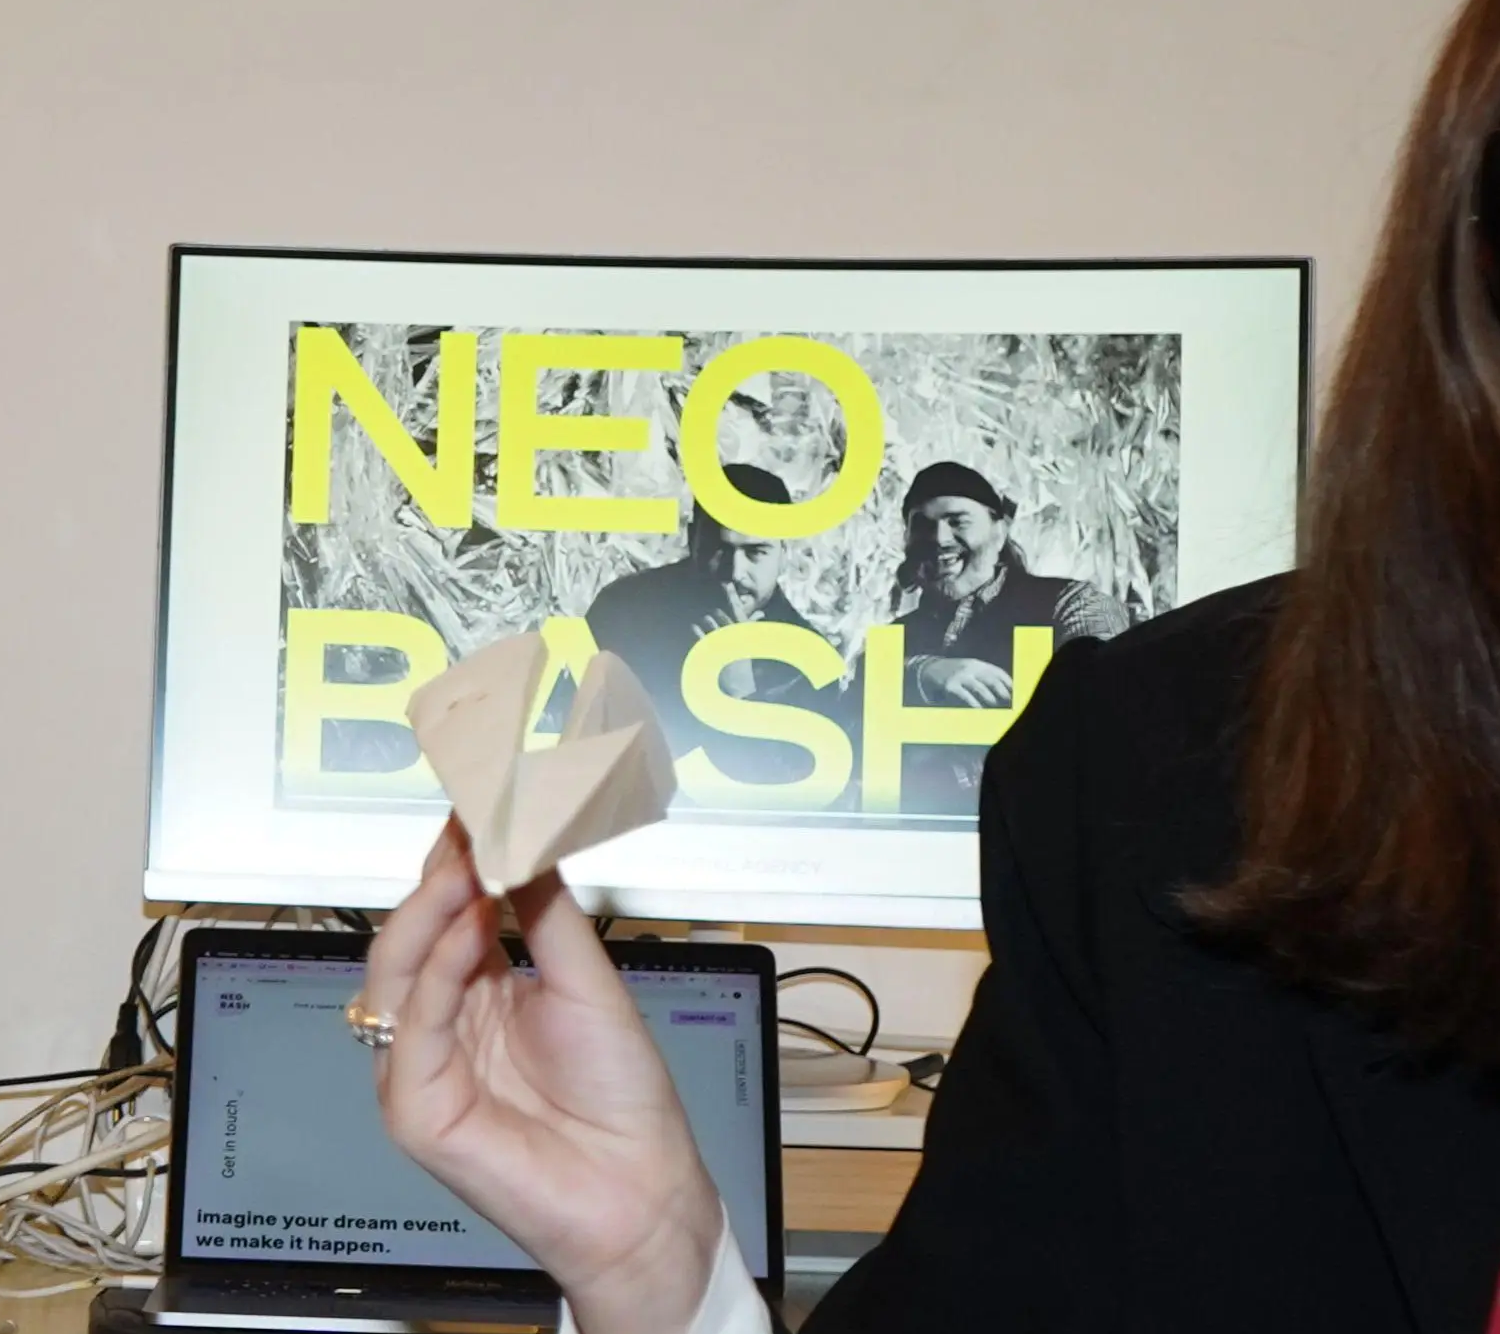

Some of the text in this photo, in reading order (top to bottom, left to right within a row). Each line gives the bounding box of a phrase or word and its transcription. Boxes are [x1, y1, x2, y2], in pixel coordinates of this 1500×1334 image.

[288, 325, 885, 539] NEO
[220, 993, 244, 1001] NEO
[220, 1001, 251, 1010] BASH
[221, 1099, 238, 1179] Get in touch
[197, 1209, 468, 1233] imagine your dream event.
[196, 1234, 392, 1255] we make it happen.
